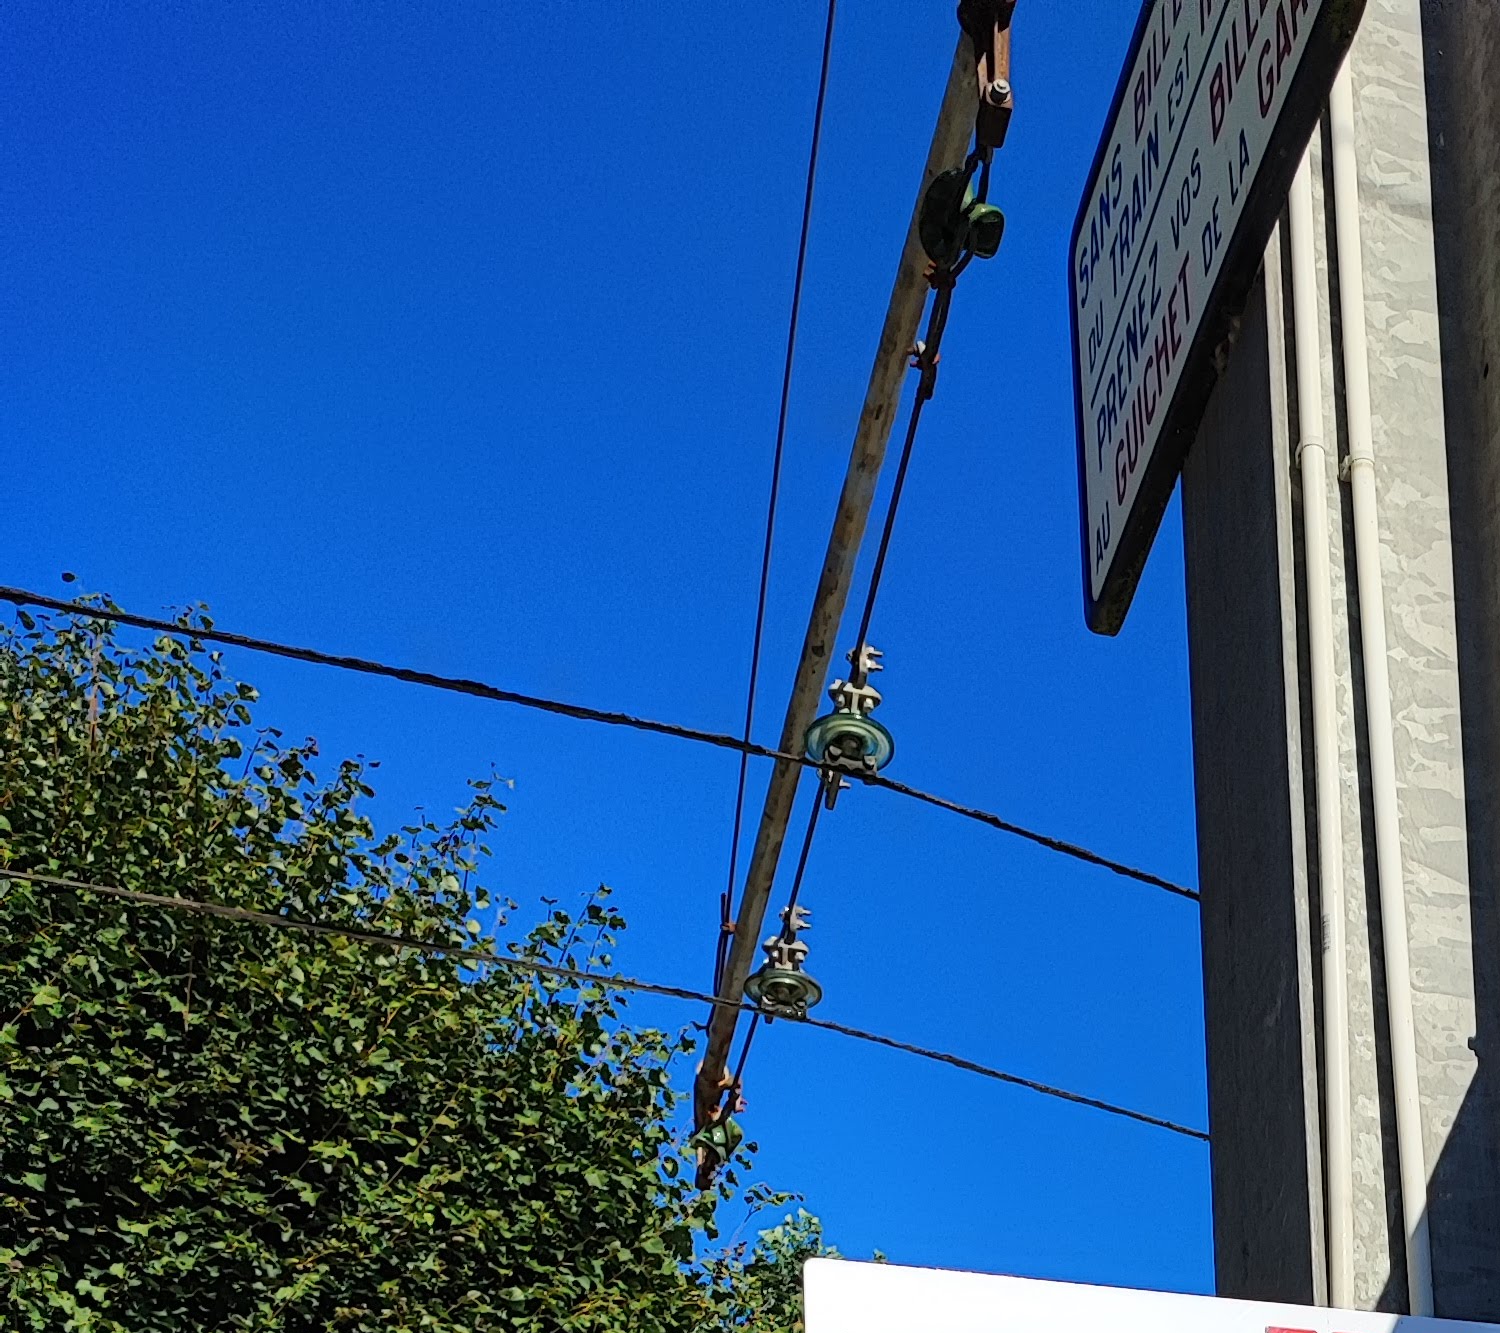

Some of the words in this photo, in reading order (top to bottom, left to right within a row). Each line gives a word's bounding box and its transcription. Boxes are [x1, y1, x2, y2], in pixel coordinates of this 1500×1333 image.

[1079, 143, 1122, 309] SANS
[1088, 300, 1104, 374] DU
[1109, 111, 1159, 298] TRAIN
[1167, 32, 1190, 132] EST
[1096, 240, 1162, 473] PRENEZ
[1171, 148, 1201, 251] VOS
[1096, 501, 1111, 575] AU
[1115, 251, 1190, 506] GUICHET
[1201, 195, 1222, 277] DE
[1228, 128, 1250, 205] LA
